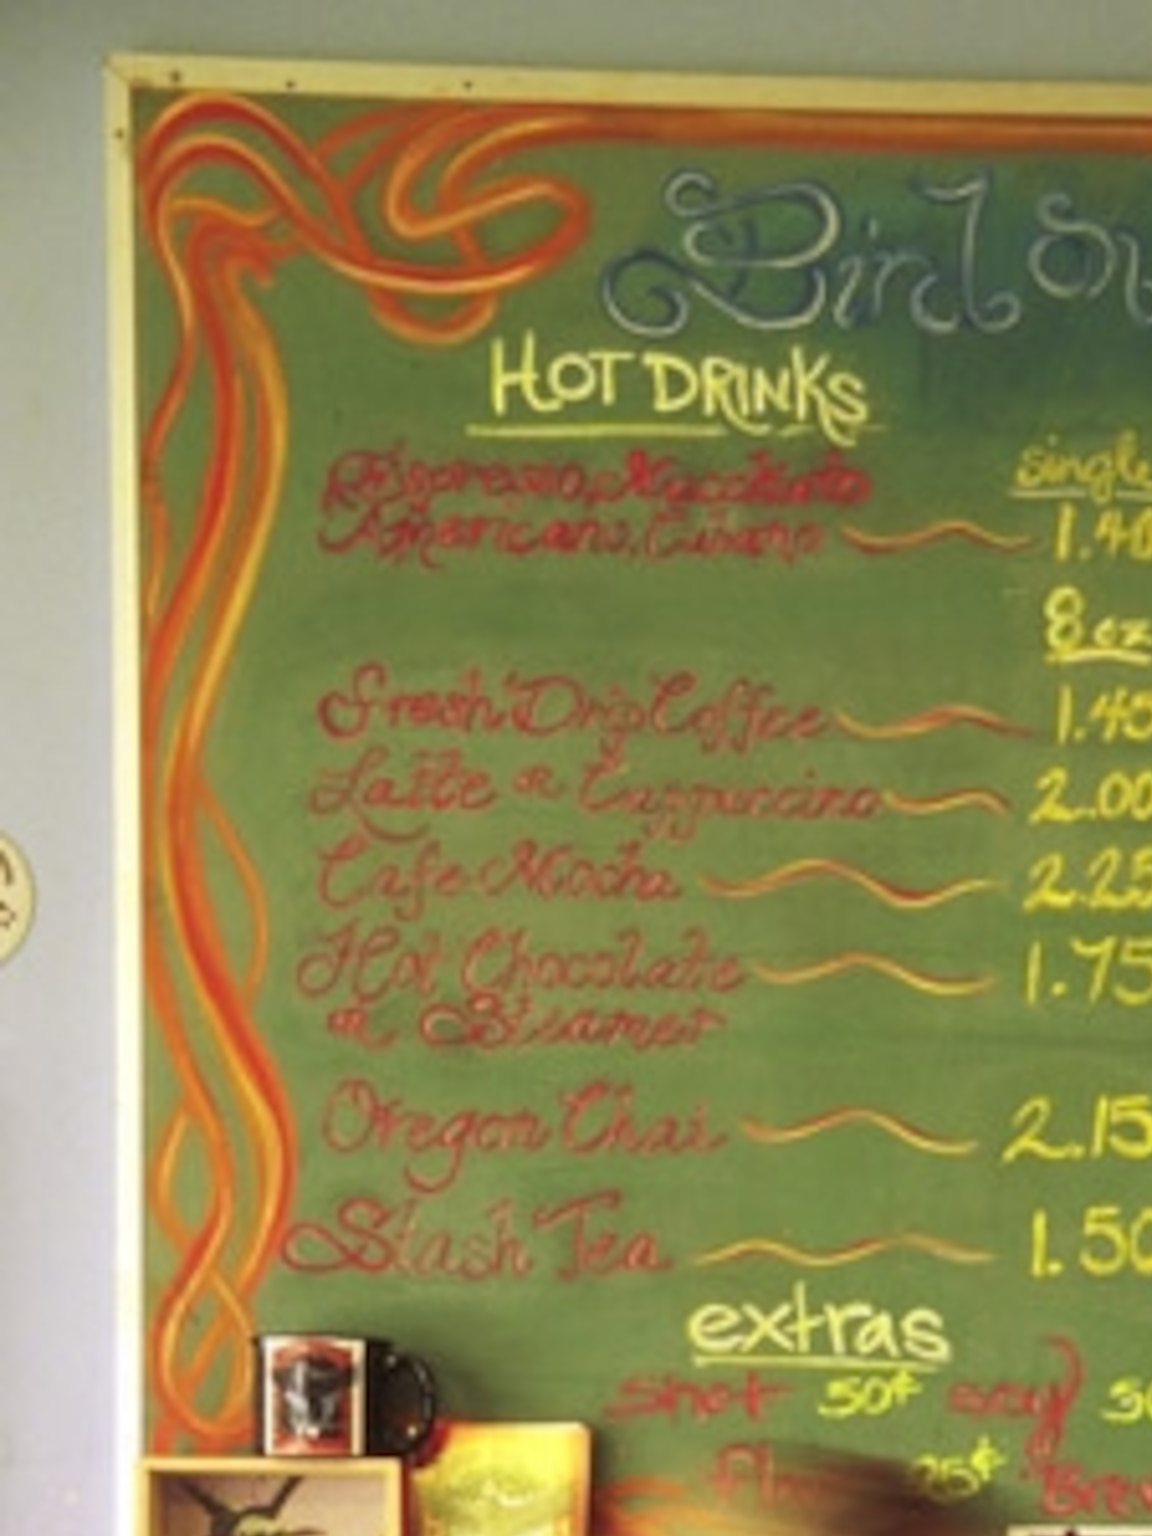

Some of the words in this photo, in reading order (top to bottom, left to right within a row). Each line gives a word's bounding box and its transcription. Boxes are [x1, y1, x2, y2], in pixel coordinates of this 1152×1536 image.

[601, 168, 1021, 338] Bird
[489, 328, 635, 416] HOT
[642, 345, 868, 447] DRINKS
[316, 661, 506, 741] Fresh
[647, 670, 826, 756] Coffee
[308, 743, 499, 842] Latte
[476, 837, 685, 903] Mocha
[297, 920, 448, 1001] Hot
[460, 928, 750, 993] Chocolate
[417, 995, 728, 1051] Steamer
[321, 1077, 553, 1195] Oregon
[556, 1075, 732, 1156] Chai
[531, 1189, 676, 1280] Tea
[686, 1282, 953, 1363] extras
